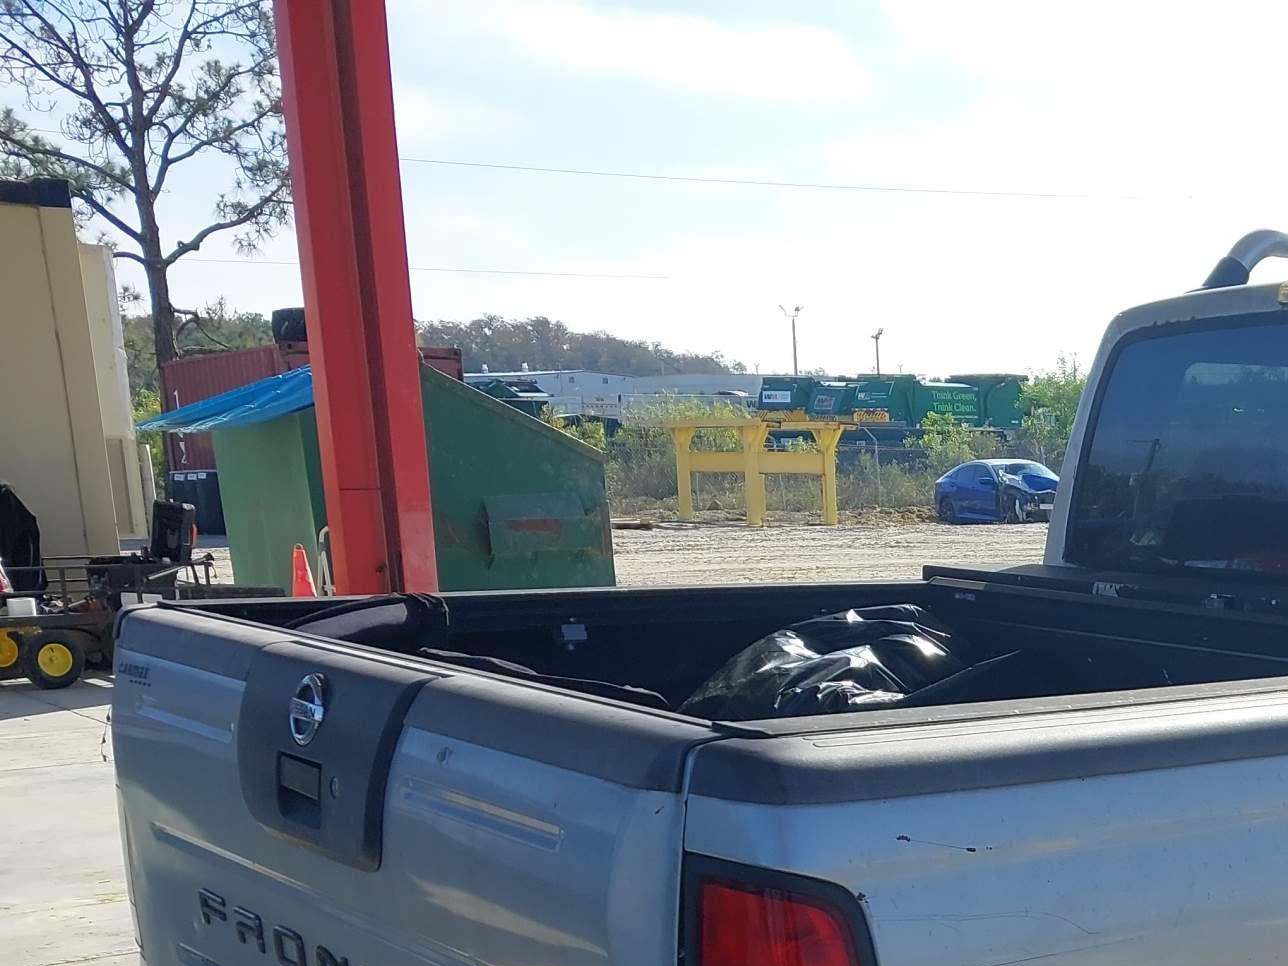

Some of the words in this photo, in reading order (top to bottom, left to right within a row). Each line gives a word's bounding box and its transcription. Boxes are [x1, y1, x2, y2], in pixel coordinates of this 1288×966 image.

[931, 390, 952, 400] Think
[952, 390, 977, 402] Green,
[933, 402, 953, 412] Think
[953, 402, 977, 412] Clean.
